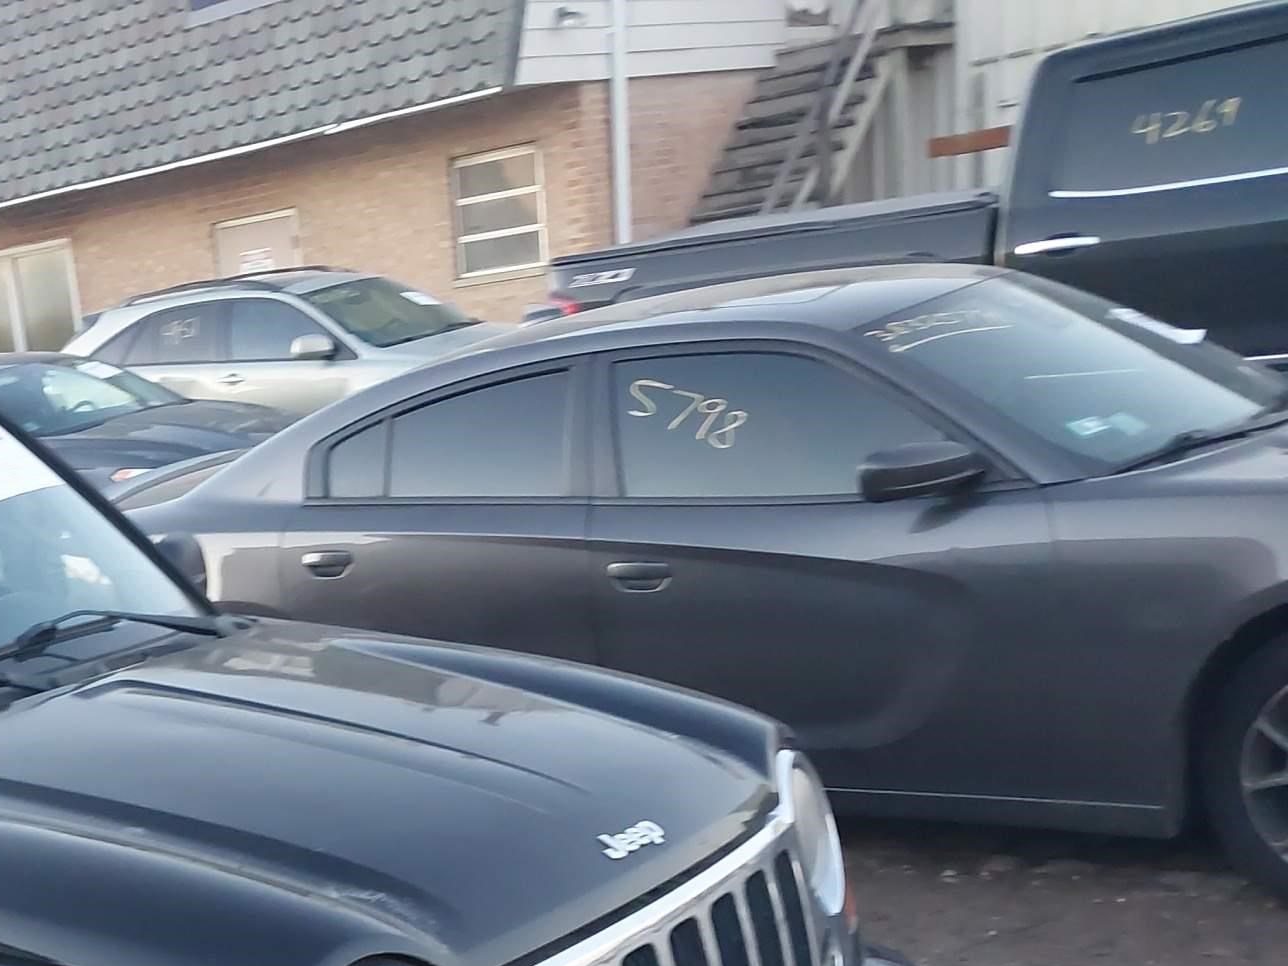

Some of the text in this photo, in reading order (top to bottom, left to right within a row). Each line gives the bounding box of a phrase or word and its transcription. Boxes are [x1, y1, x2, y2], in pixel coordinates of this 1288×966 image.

[1130, 96, 1243, 145] 4269
[626, 379, 749, 449] 5798
[595, 819, 666, 860] Jeep
